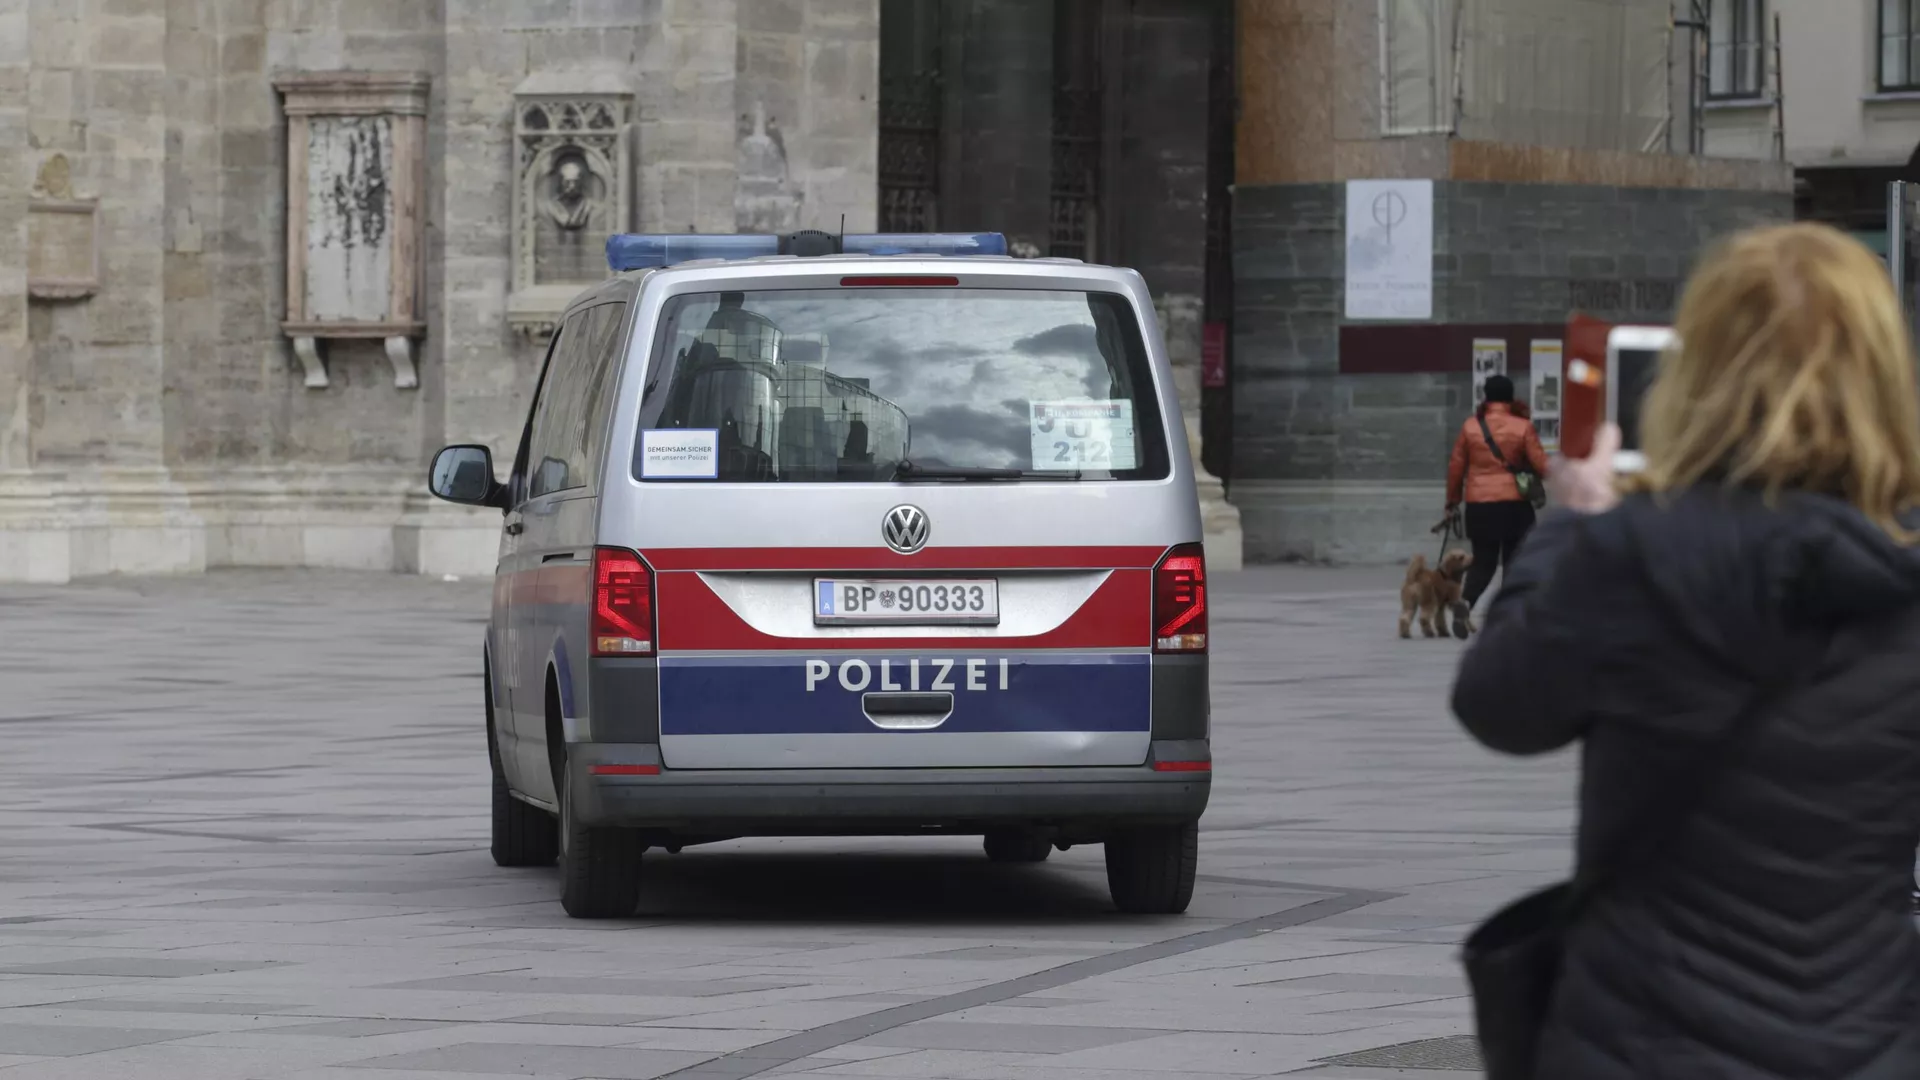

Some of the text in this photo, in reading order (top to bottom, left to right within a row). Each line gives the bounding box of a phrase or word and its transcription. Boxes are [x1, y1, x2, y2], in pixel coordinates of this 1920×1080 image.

[1053, 441, 1108, 462] 212
[882, 503, 931, 555] VW
[823, 602, 831, 611] A
[844, 585, 985, 612] BP 90333
[805, 658, 1009, 692] POLIZEI
